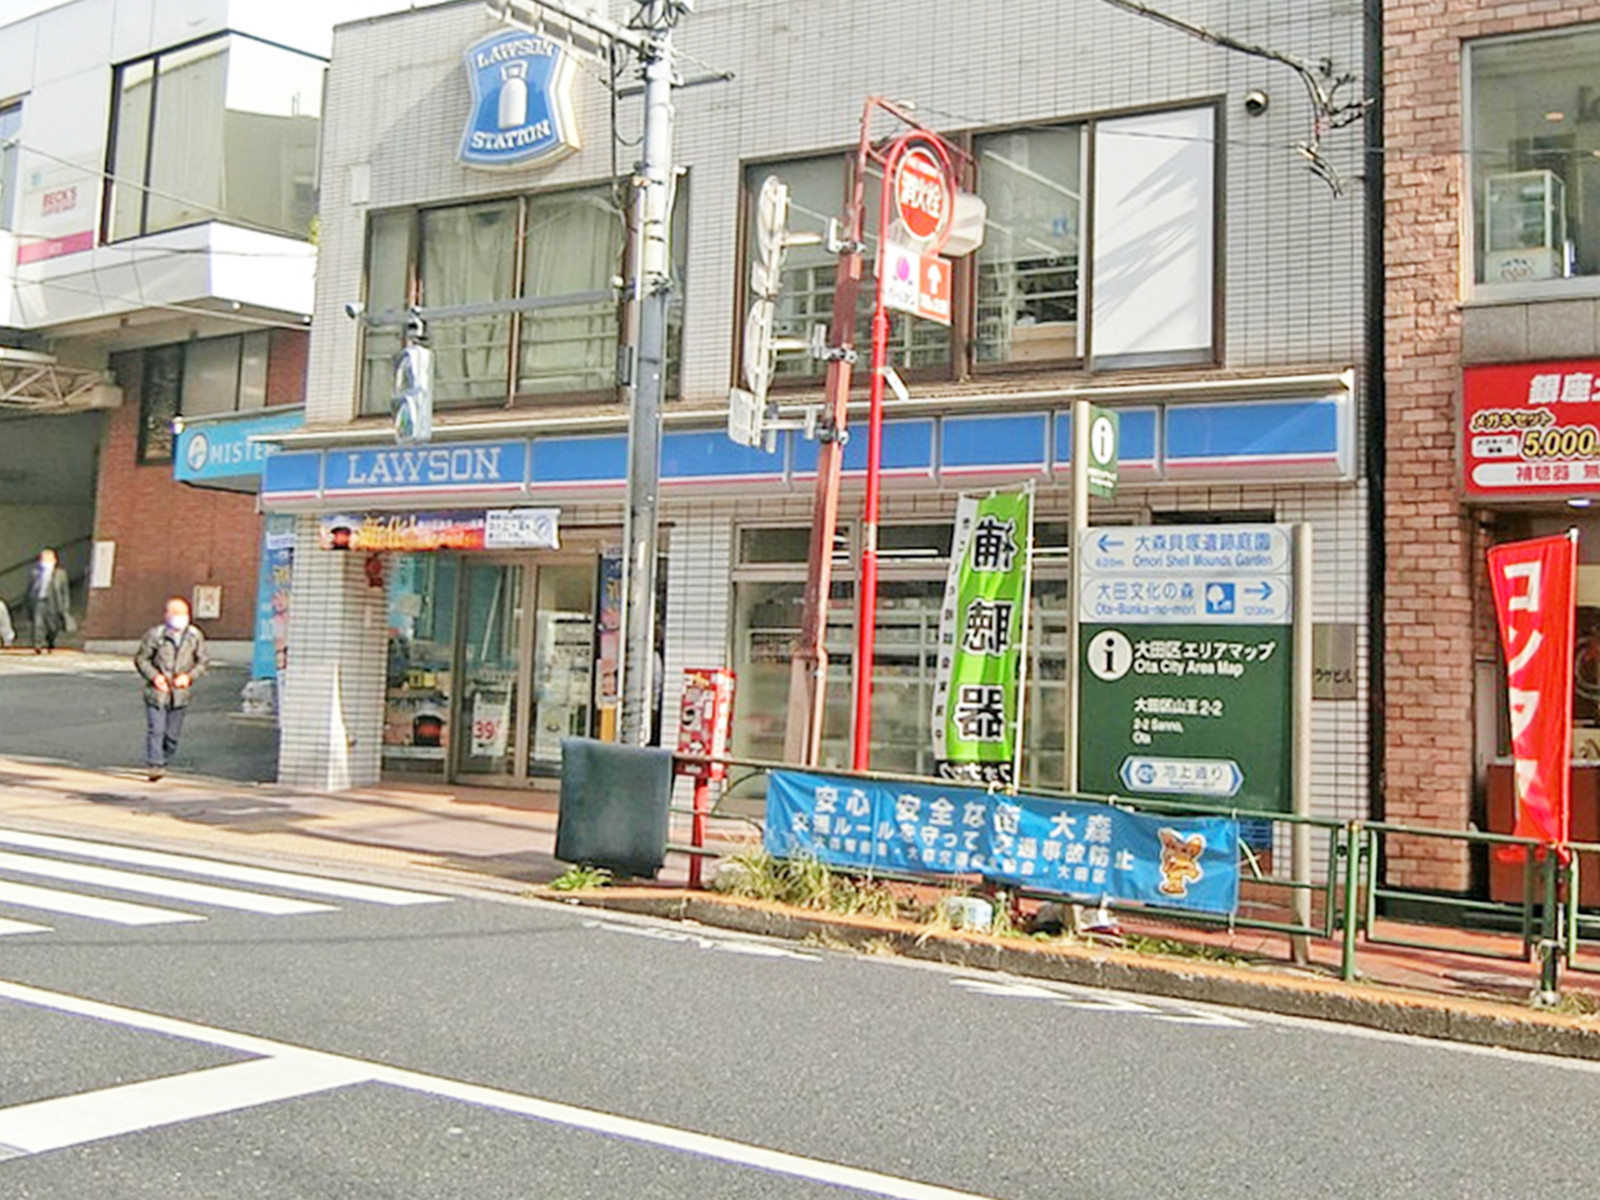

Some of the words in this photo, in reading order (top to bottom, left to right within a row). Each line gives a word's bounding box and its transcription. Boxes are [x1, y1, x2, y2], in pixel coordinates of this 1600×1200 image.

[476, 38, 555, 69] LAWSON
[471, 119, 552, 149] STATION
[901, 171, 941, 219] 消火栓
[347, 447, 502, 485] LAWSON
[1516, 465, 1570, 482] 補聴器
[1133, 553, 1163, 567] Omori
[1166, 553, 1190, 567] Shell
[1194, 554, 1232, 567] Mounds
[1235, 554, 1273, 567] Garden
[1096, 582, 1194, 600] 大田文化の森
[1134, 640, 1276, 661] 大田区エリアマップ
[1133, 660, 1158, 675] Ota
[1160, 660, 1185, 677] City
[1186, 660, 1216, 675] Area
[1217, 661, 1244, 678] Map
[815, 786, 871, 817] 安心
[1049, 811, 1112, 843] 大森
